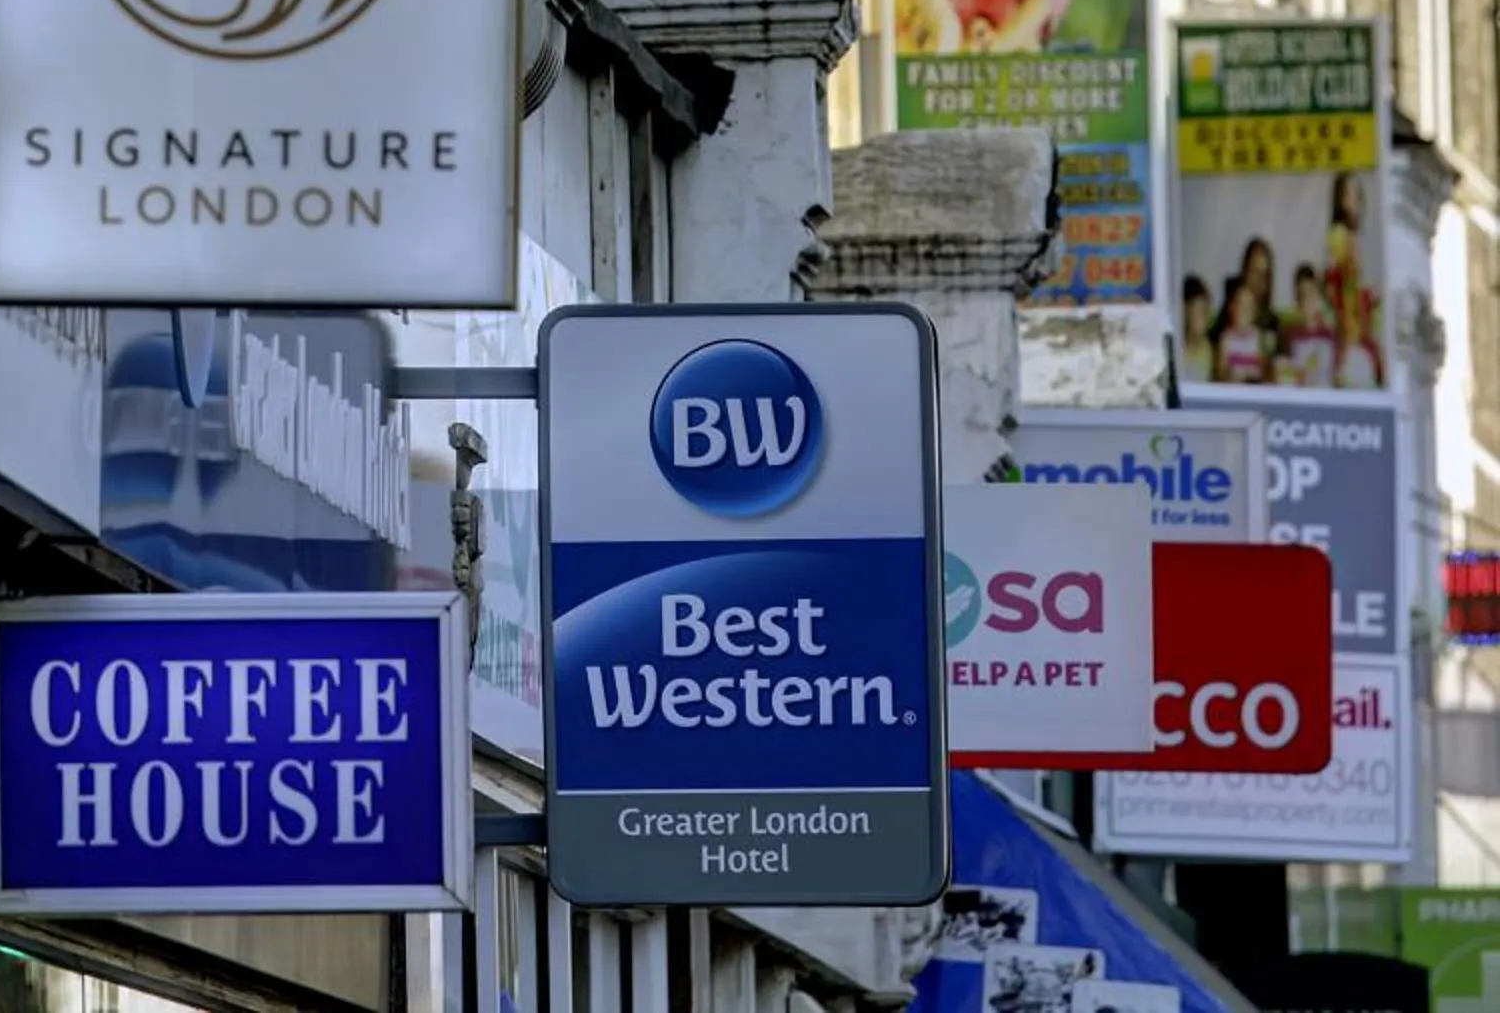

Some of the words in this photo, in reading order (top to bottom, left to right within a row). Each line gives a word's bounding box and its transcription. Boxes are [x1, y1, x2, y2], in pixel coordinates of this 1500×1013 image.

[24, 127, 458, 172] SIGNATURE
[100, 185, 385, 228] LONDON
[671, 395, 807, 469] BW
[1270, 421, 1383, 451] OCATION
[1161, 508, 1187, 525] for
[661, 593, 827, 659] Best
[586, 663, 899, 729] Western
[947, 661, 1009, 687] ELP
[1014, 661, 1037, 686] A
[1044, 661, 1106, 687] PET
[30, 658, 409, 747] COFFEE
[1152, 680, 1300, 750] CCO
[56, 759, 386, 849] HOUSE
[618, 807, 741, 837] Greater
[750, 805, 870, 836] London
[700, 844, 790, 874] Hotel
